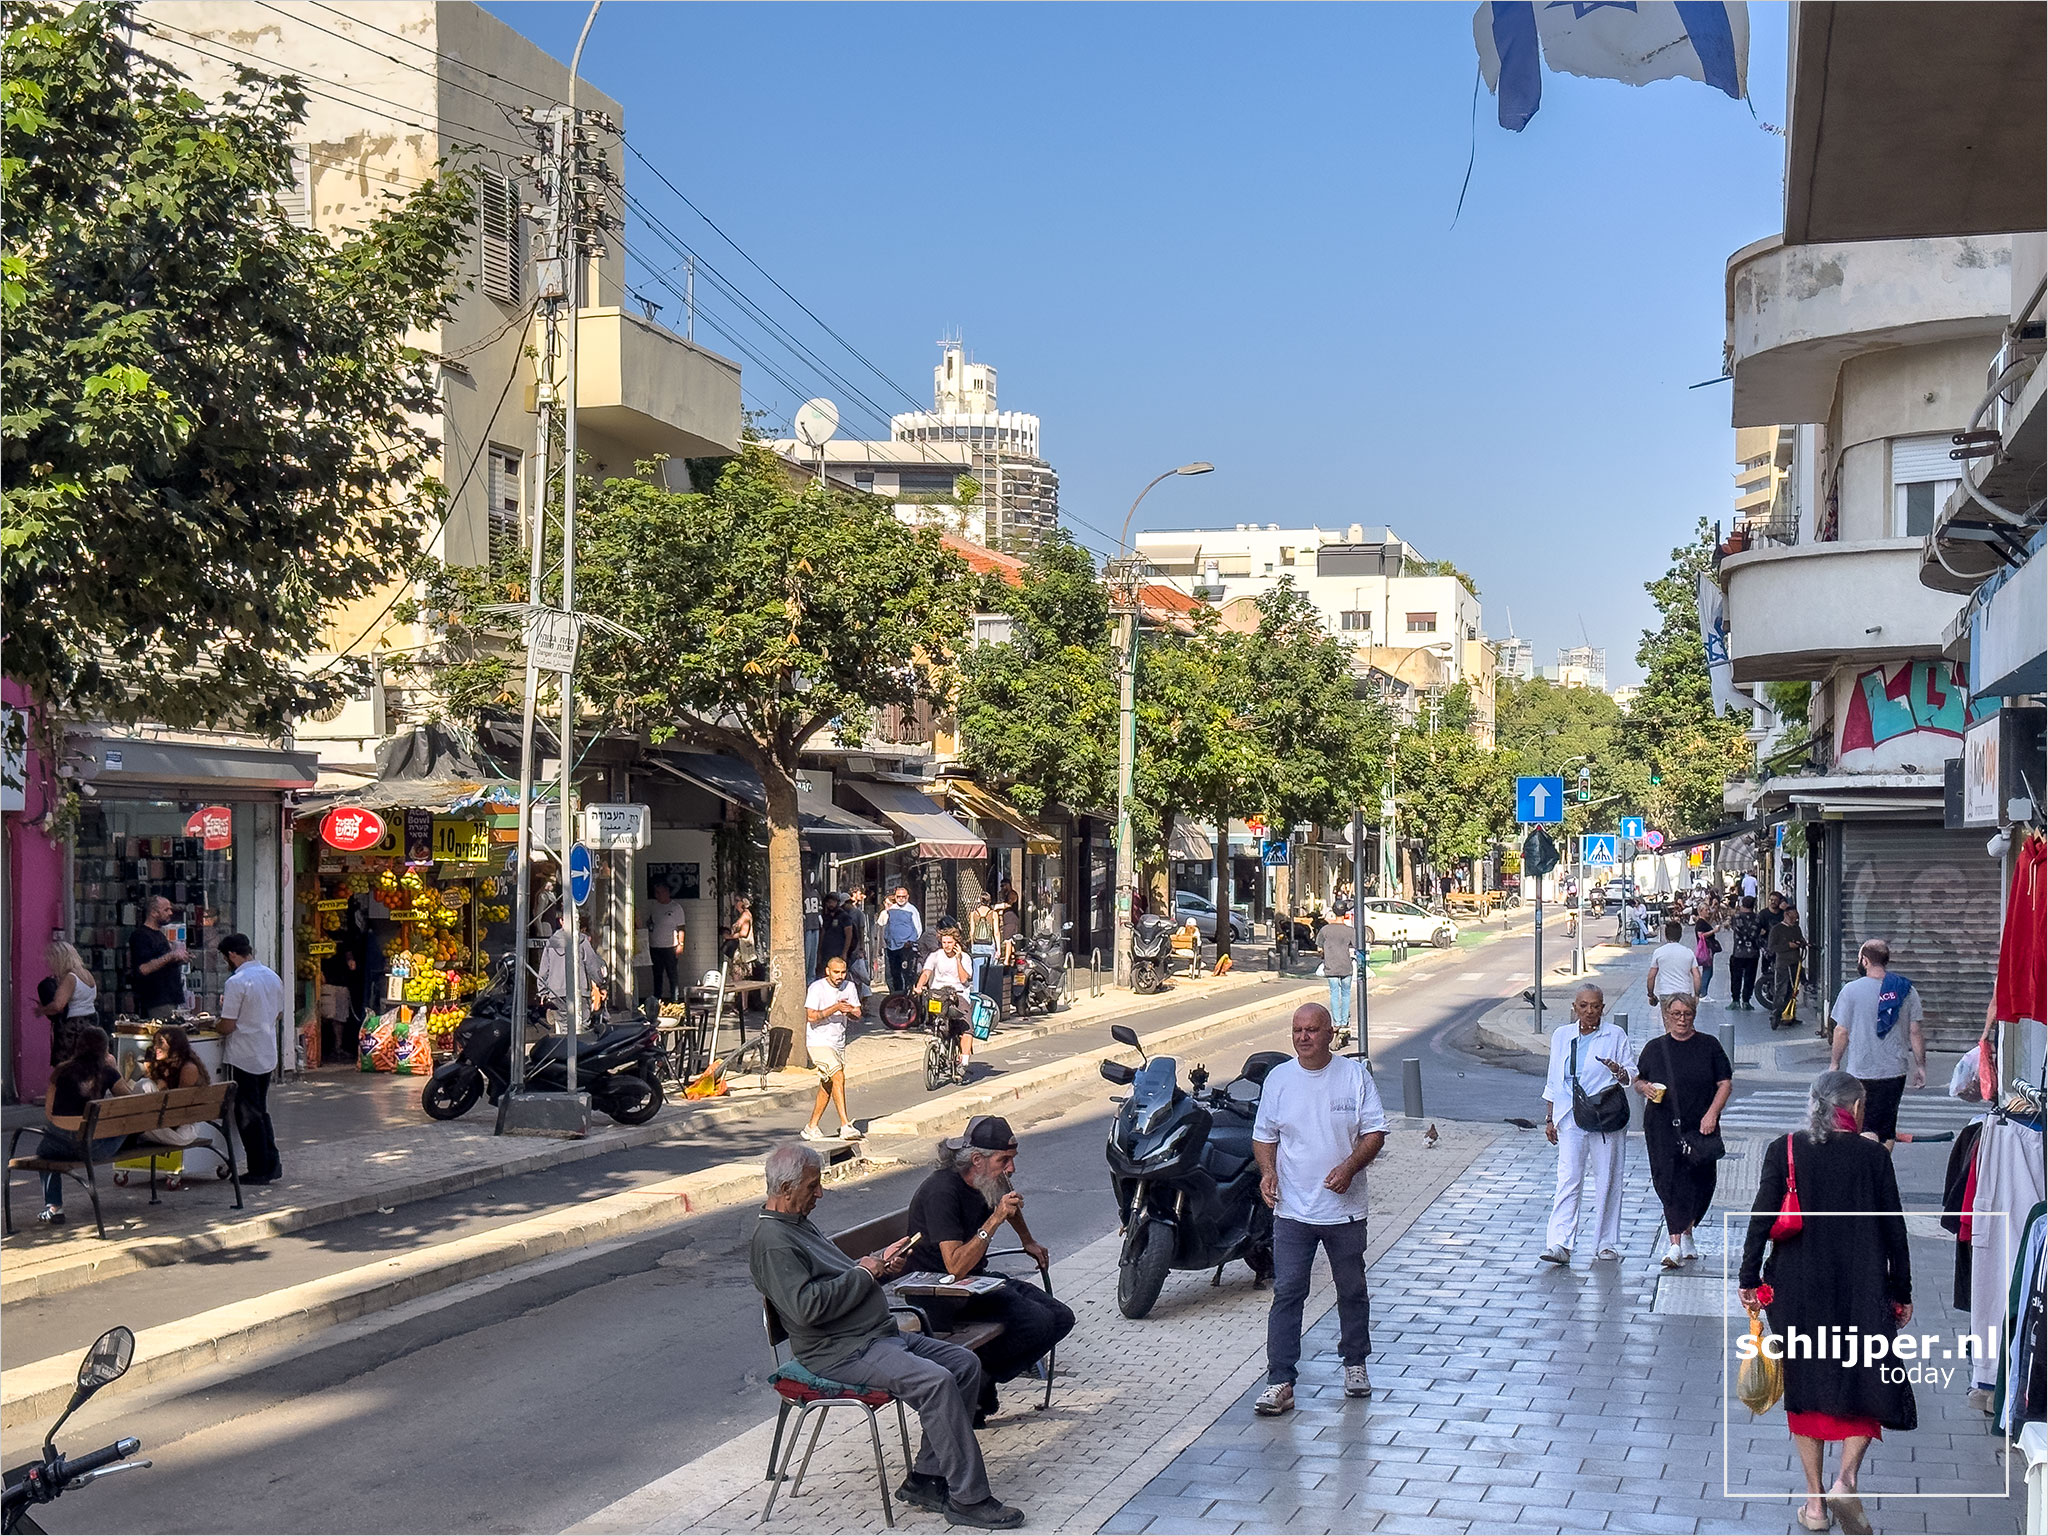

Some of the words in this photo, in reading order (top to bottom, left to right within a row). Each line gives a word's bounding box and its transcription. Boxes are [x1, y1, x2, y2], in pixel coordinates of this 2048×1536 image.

[407, 816, 430, 824] Bowl
[591, 811, 625, 821] העבודה
[408, 824, 429, 832] קערת
[409, 831, 429, 839] אסאי
[455, 842, 487, 858] תפוזים
[804, 897, 819, 914] 18
